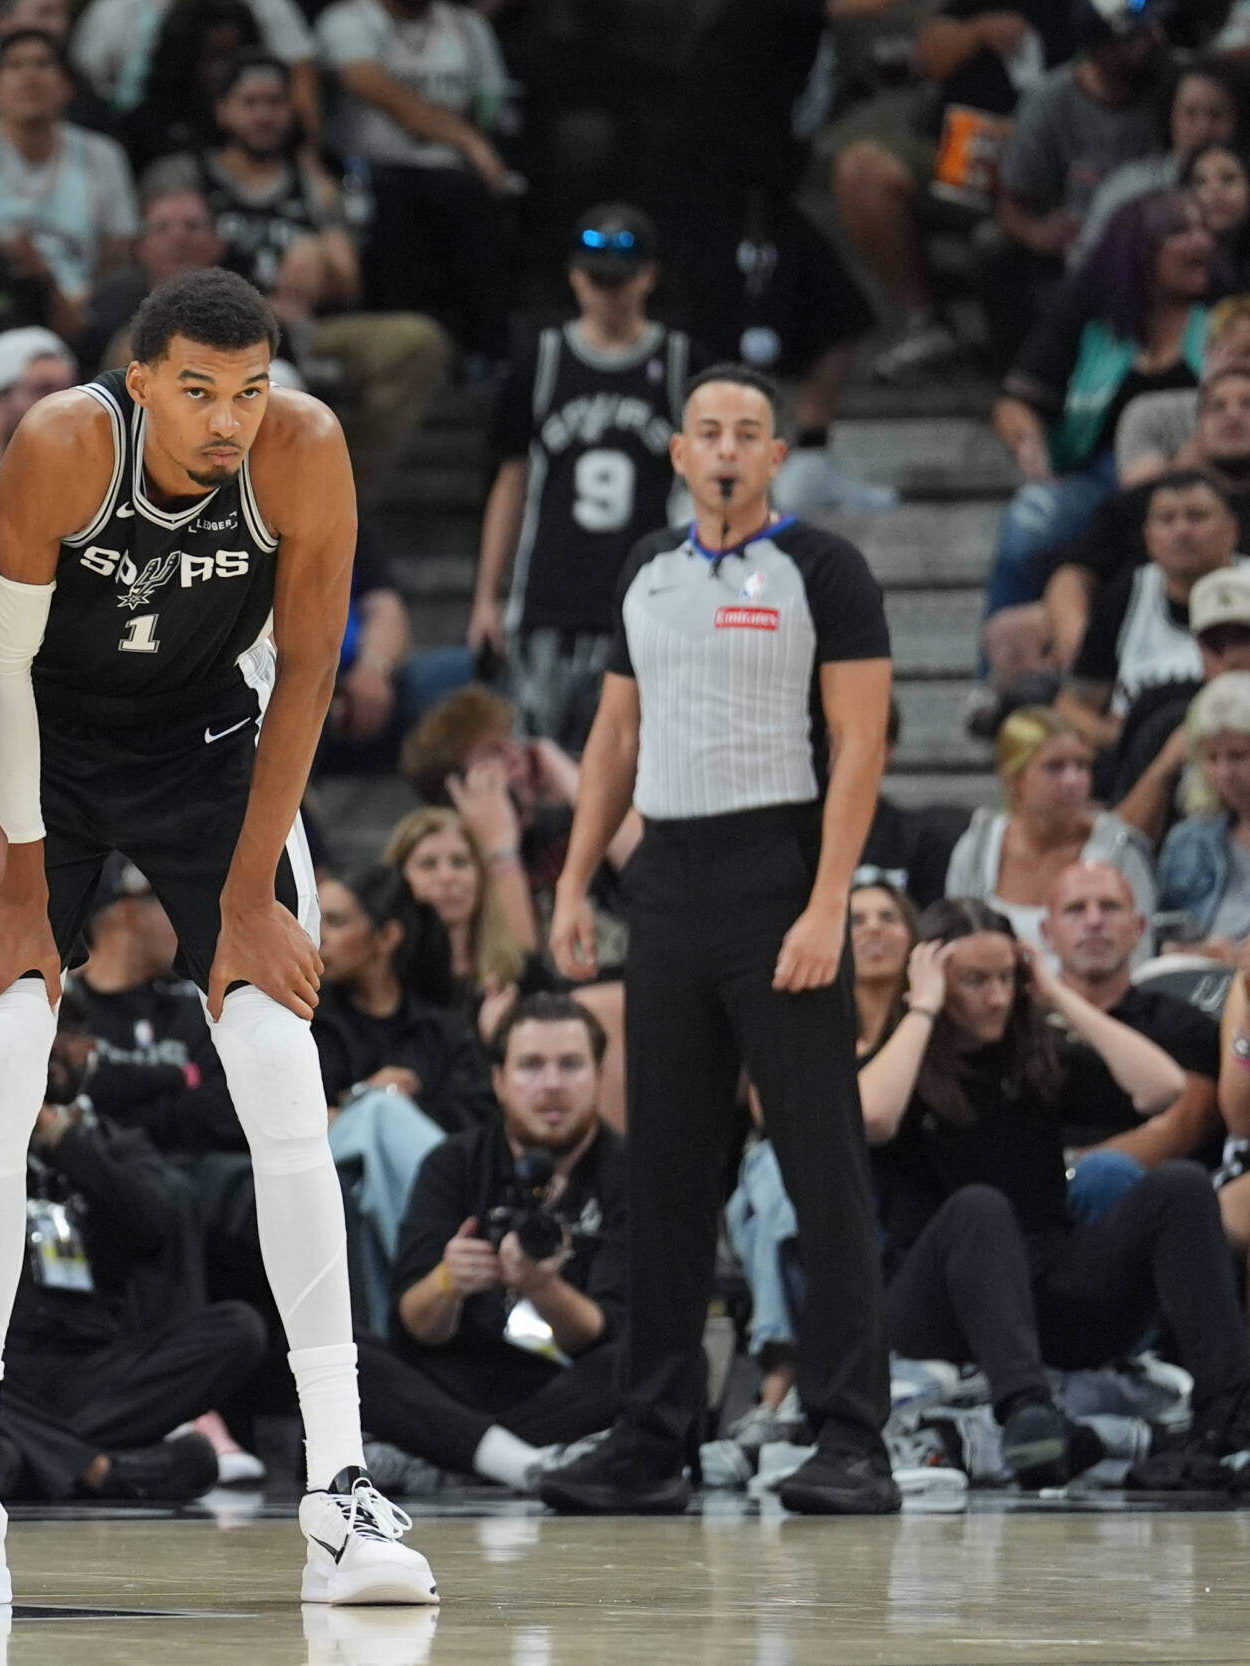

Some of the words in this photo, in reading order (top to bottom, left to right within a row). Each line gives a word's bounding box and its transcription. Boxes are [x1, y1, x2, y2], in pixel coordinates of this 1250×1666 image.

[574, 449, 635, 531] 9
[196, 518, 232, 531] LEDGER
[716, 609, 777, 627] Emirates
[118, 614, 160, 653] 1
